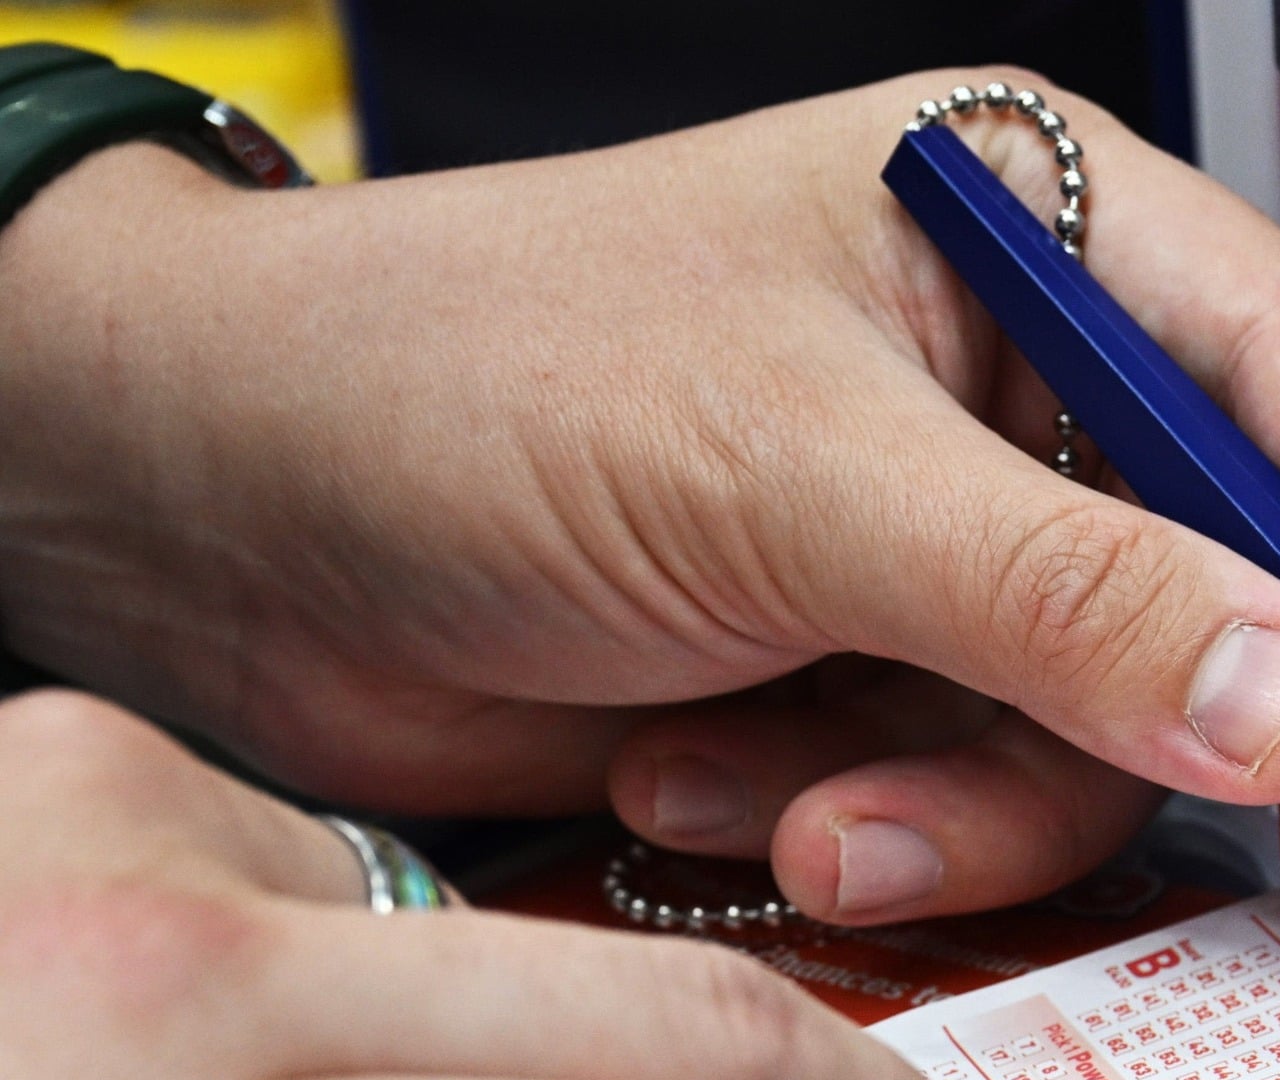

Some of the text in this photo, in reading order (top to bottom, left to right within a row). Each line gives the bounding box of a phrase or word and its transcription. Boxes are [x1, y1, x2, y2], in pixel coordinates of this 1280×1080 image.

[1125, 946, 1181, 978] B
[1041, 1023, 1077, 1050] Pick
[1063, 1047, 1078, 1057] 1
